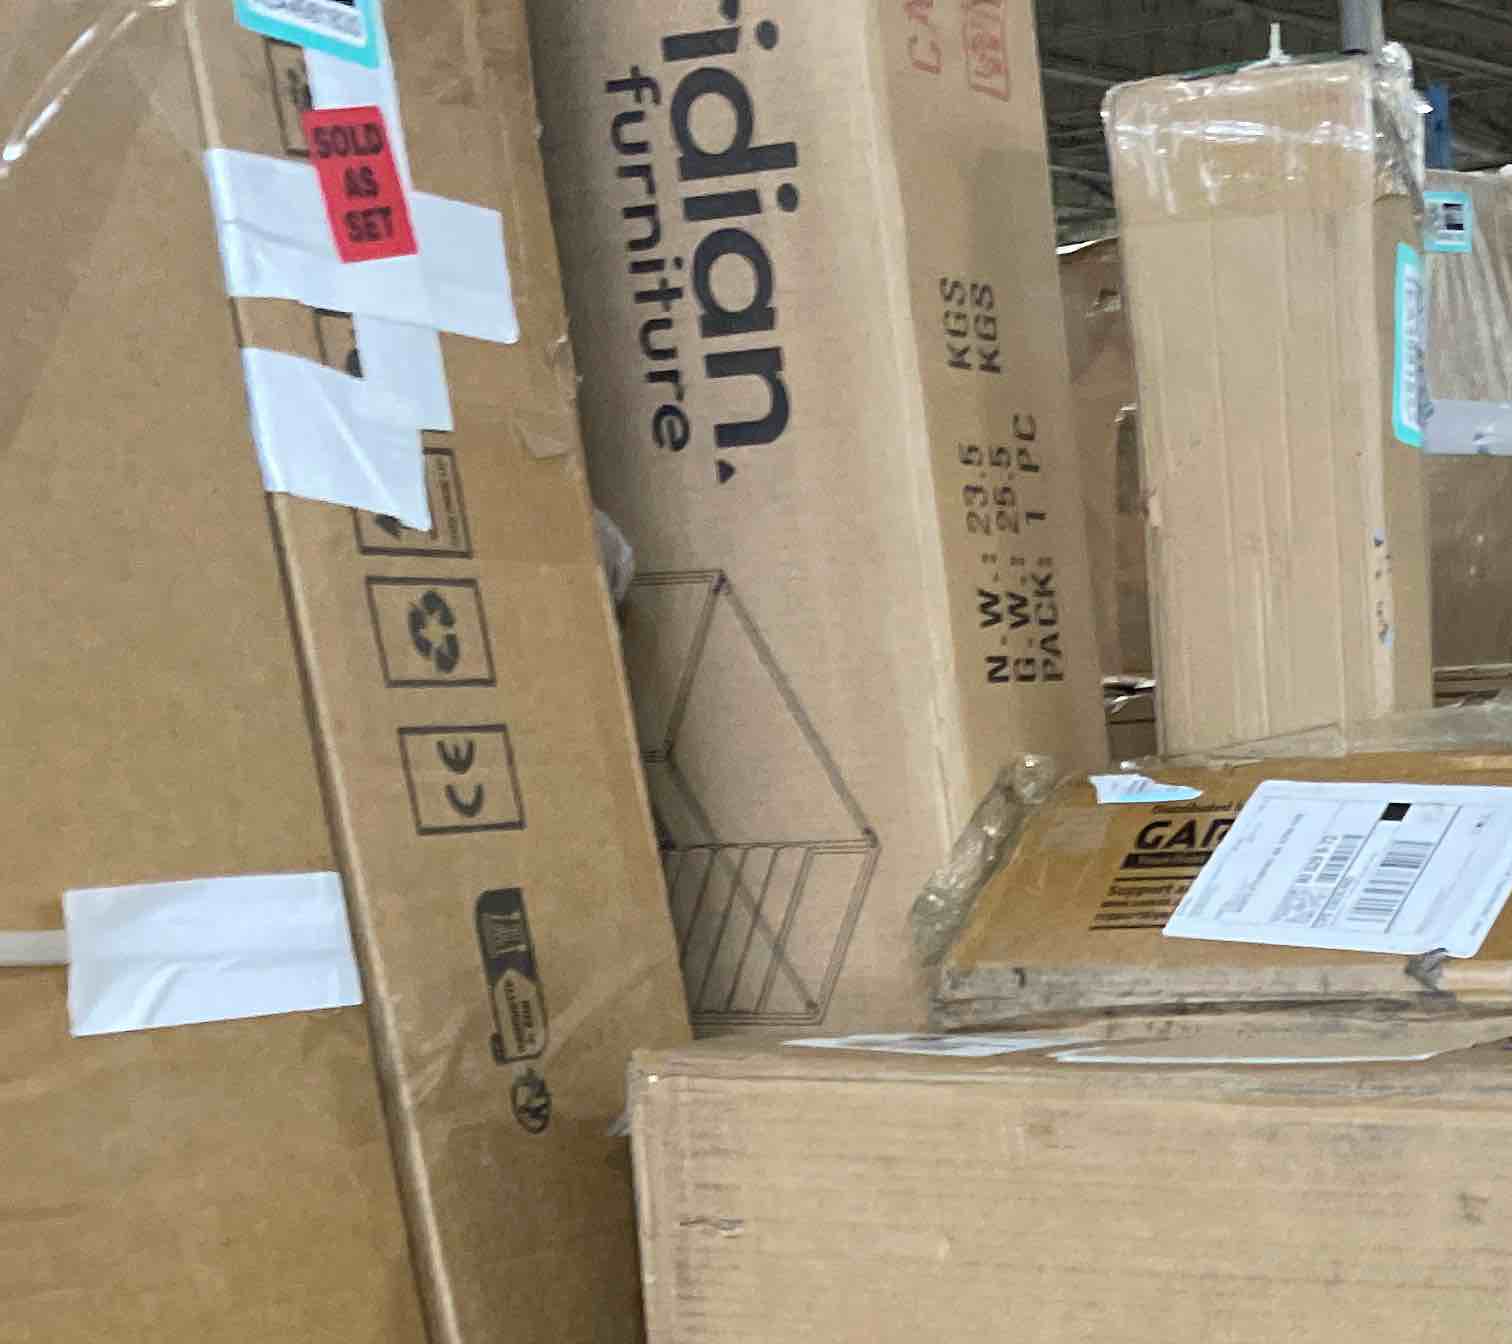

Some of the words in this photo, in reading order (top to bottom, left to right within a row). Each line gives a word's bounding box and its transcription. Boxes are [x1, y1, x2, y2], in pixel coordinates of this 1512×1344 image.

[314, 122, 382, 159] SOLD
[344, 166, 378, 196] AS
[346, 206, 392, 242] SET
[605, 65, 690, 453] furniture
[661, 0, 801, 449] idian
[940, 277, 973, 371] KGS
[970, 282, 1001, 374] KGS
[1012, 414, 1041, 474] PC
